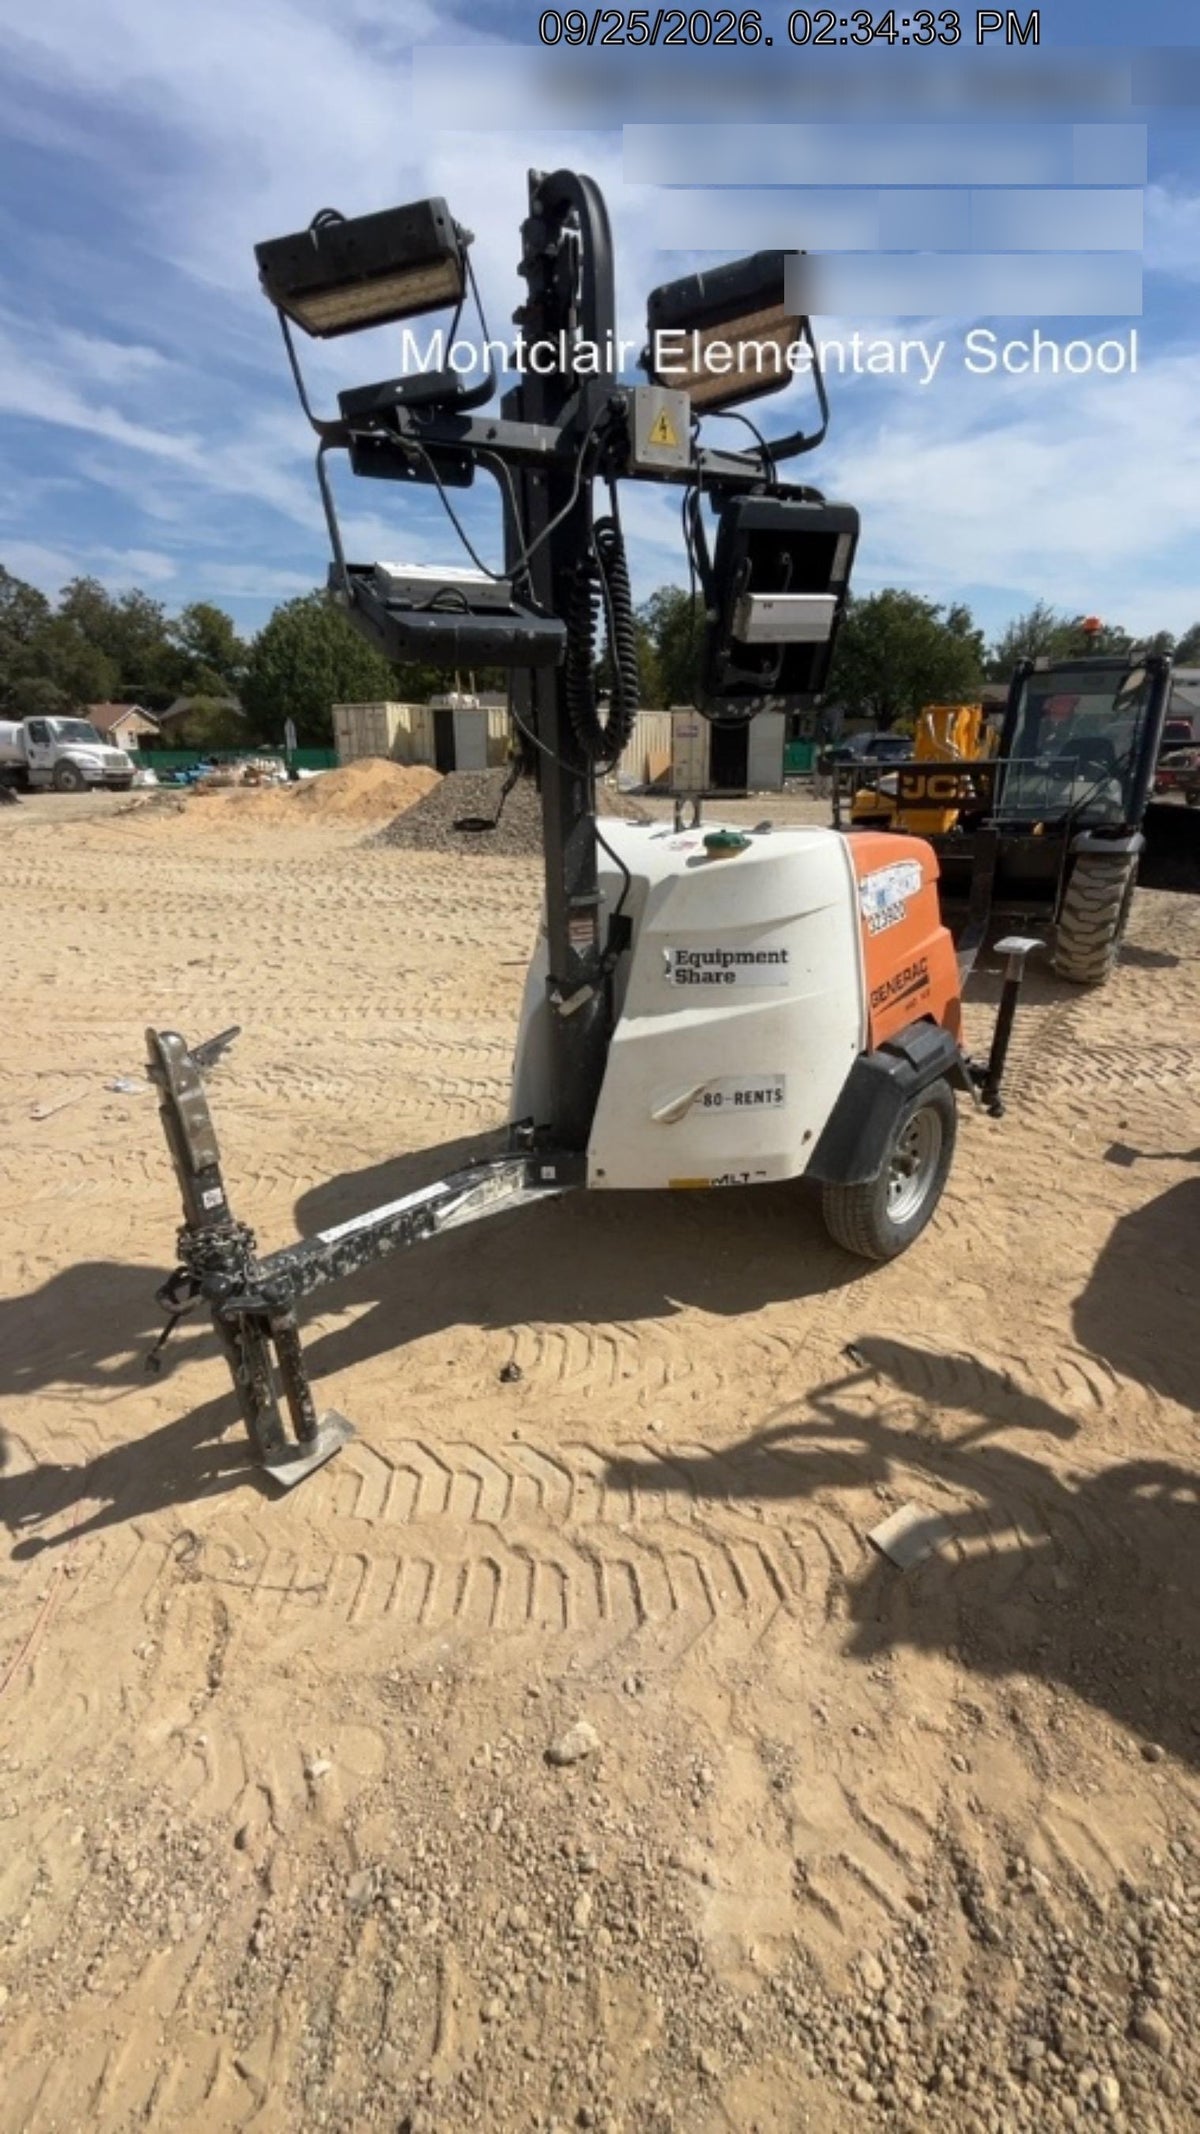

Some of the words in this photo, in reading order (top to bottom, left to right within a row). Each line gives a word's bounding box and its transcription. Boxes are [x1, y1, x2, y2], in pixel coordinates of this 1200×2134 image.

[675, 949, 788, 968] Equipment
[675, 969, 737, 984] Share
[870, 957, 928, 1009] GENERAC
